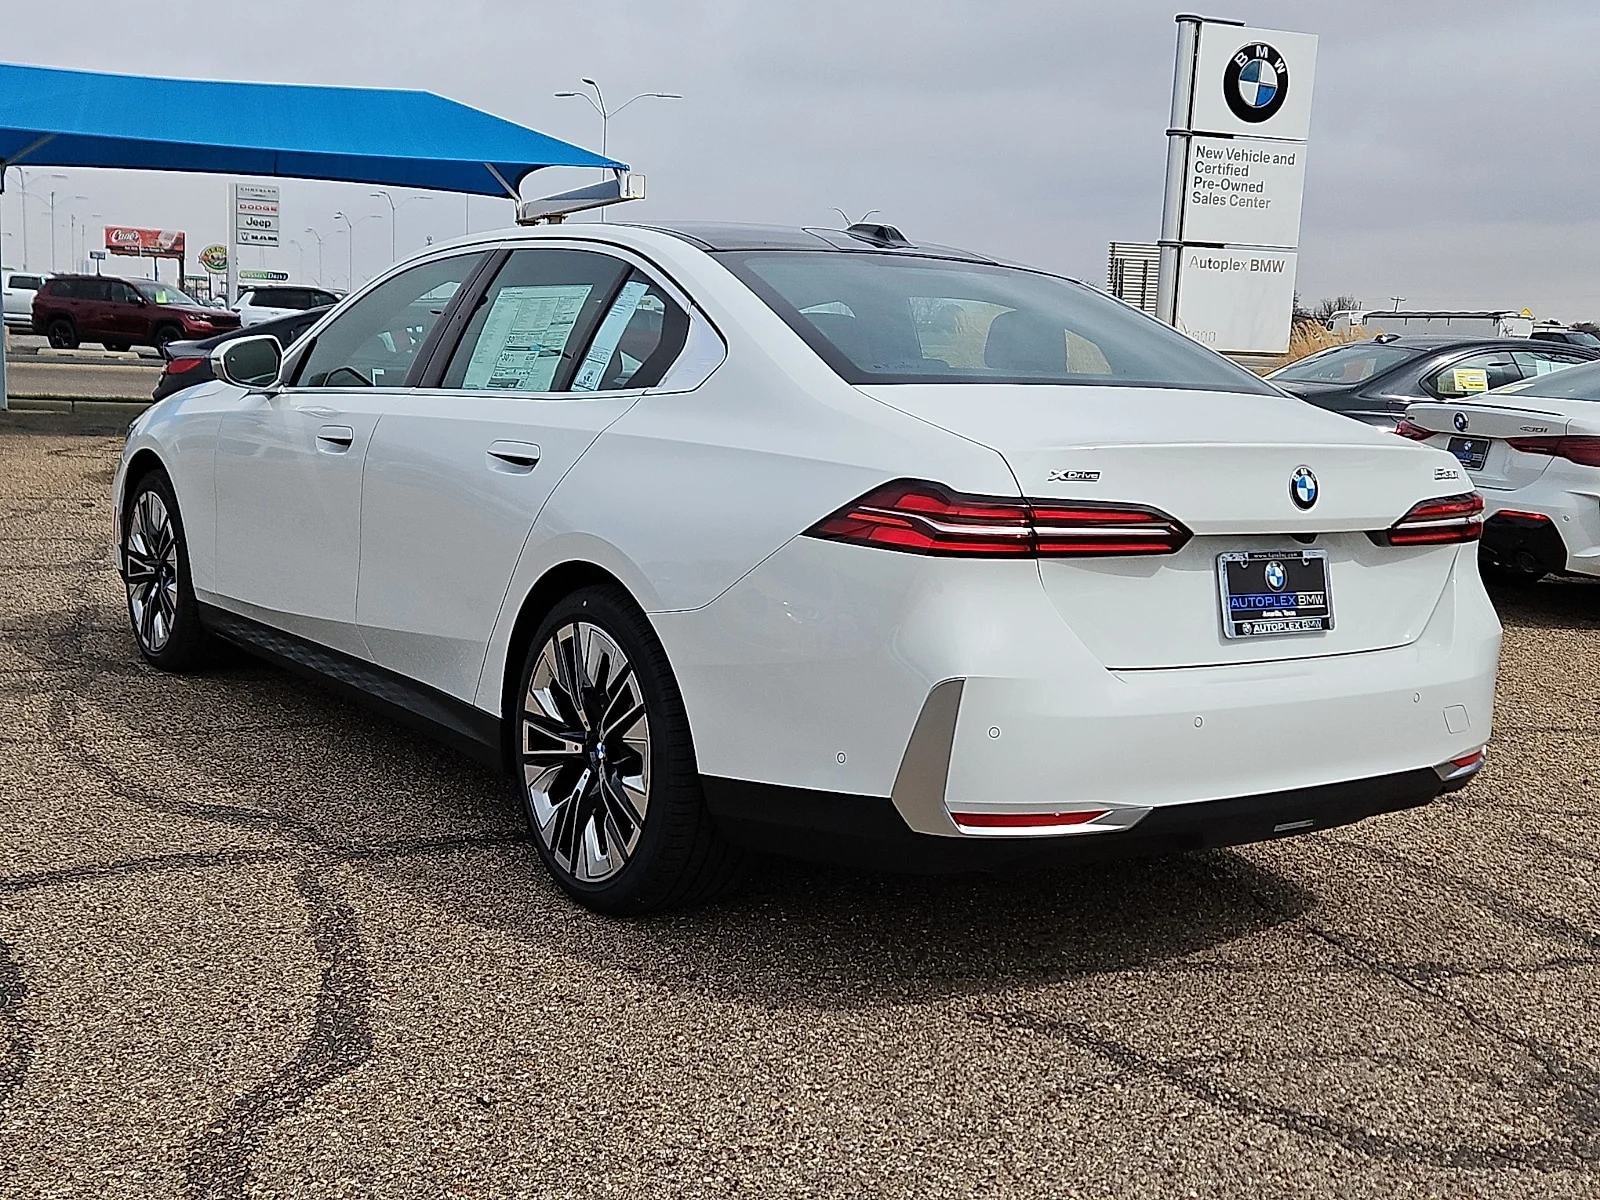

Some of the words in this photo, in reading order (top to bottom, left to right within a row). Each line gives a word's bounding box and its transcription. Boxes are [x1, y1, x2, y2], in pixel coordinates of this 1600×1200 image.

[1233, 44, 1286, 74] BMW
[1195, 145, 1223, 159] New
[1226, 147, 1271, 163] Vehicle
[1273, 153, 1296, 165] and
[1194, 160, 1249, 177] Certified
[1193, 176, 1264, 193] Pre-Owned
[240, 203, 278, 212] DODGE
[1192, 191, 1227, 206] Sales
[1229, 194, 1271, 208] Center
[245, 216, 272, 229] Jeep
[1189, 255, 1248, 272] Autoplex
[1250, 259, 1285, 273] BMW
[1230, 595, 1297, 608] AUTOPLEX
[1297, 594, 1324, 606] BMW
[1253, 621, 1301, 633] AUTOPLEX
[1301, 619, 1322, 629] BMW
